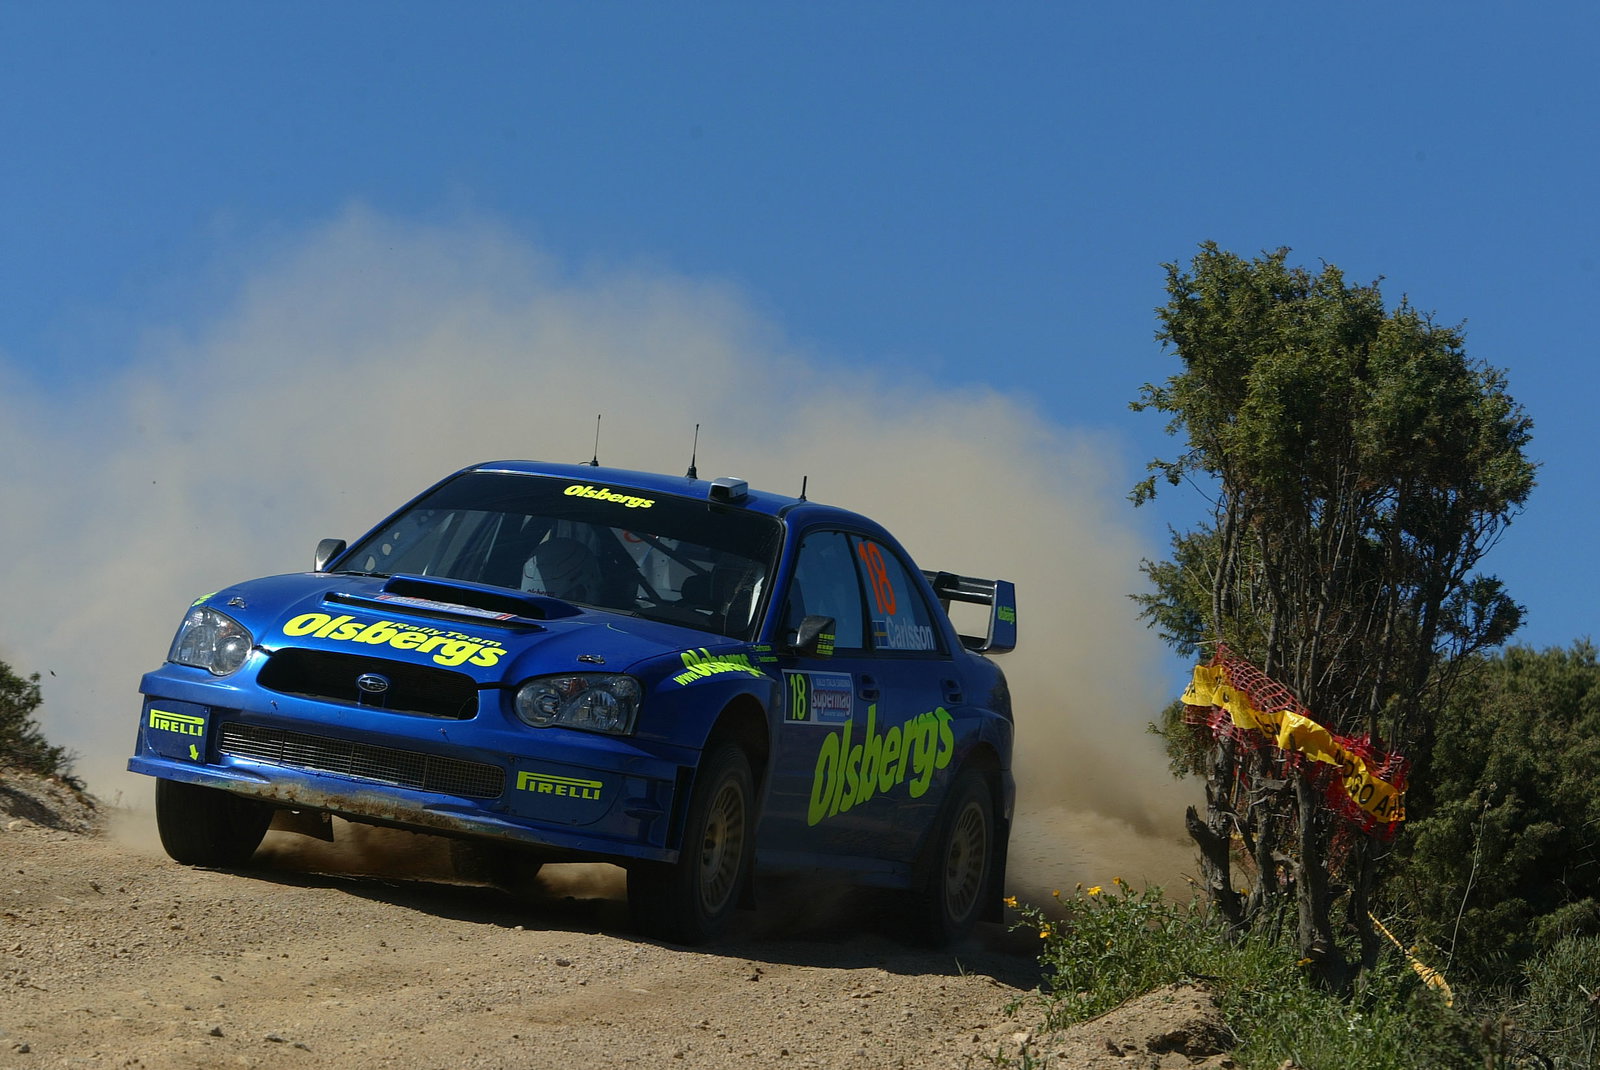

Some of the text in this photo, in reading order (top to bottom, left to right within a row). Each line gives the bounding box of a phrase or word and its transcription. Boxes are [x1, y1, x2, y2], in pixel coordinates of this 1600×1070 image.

[564, 484, 655, 508] Olsbergs
[857, 541, 897, 616] 18
[282, 612, 508, 668] Olsbergs
[389, 622, 502, 648] Rally Team
[886, 616, 937, 651] Carlsson
[789, 673, 806, 721] 18
[149, 708, 205, 737] PIRELLI
[807, 703, 954, 827] Olsbergs
[516, 770, 603, 800] PIRELLI
